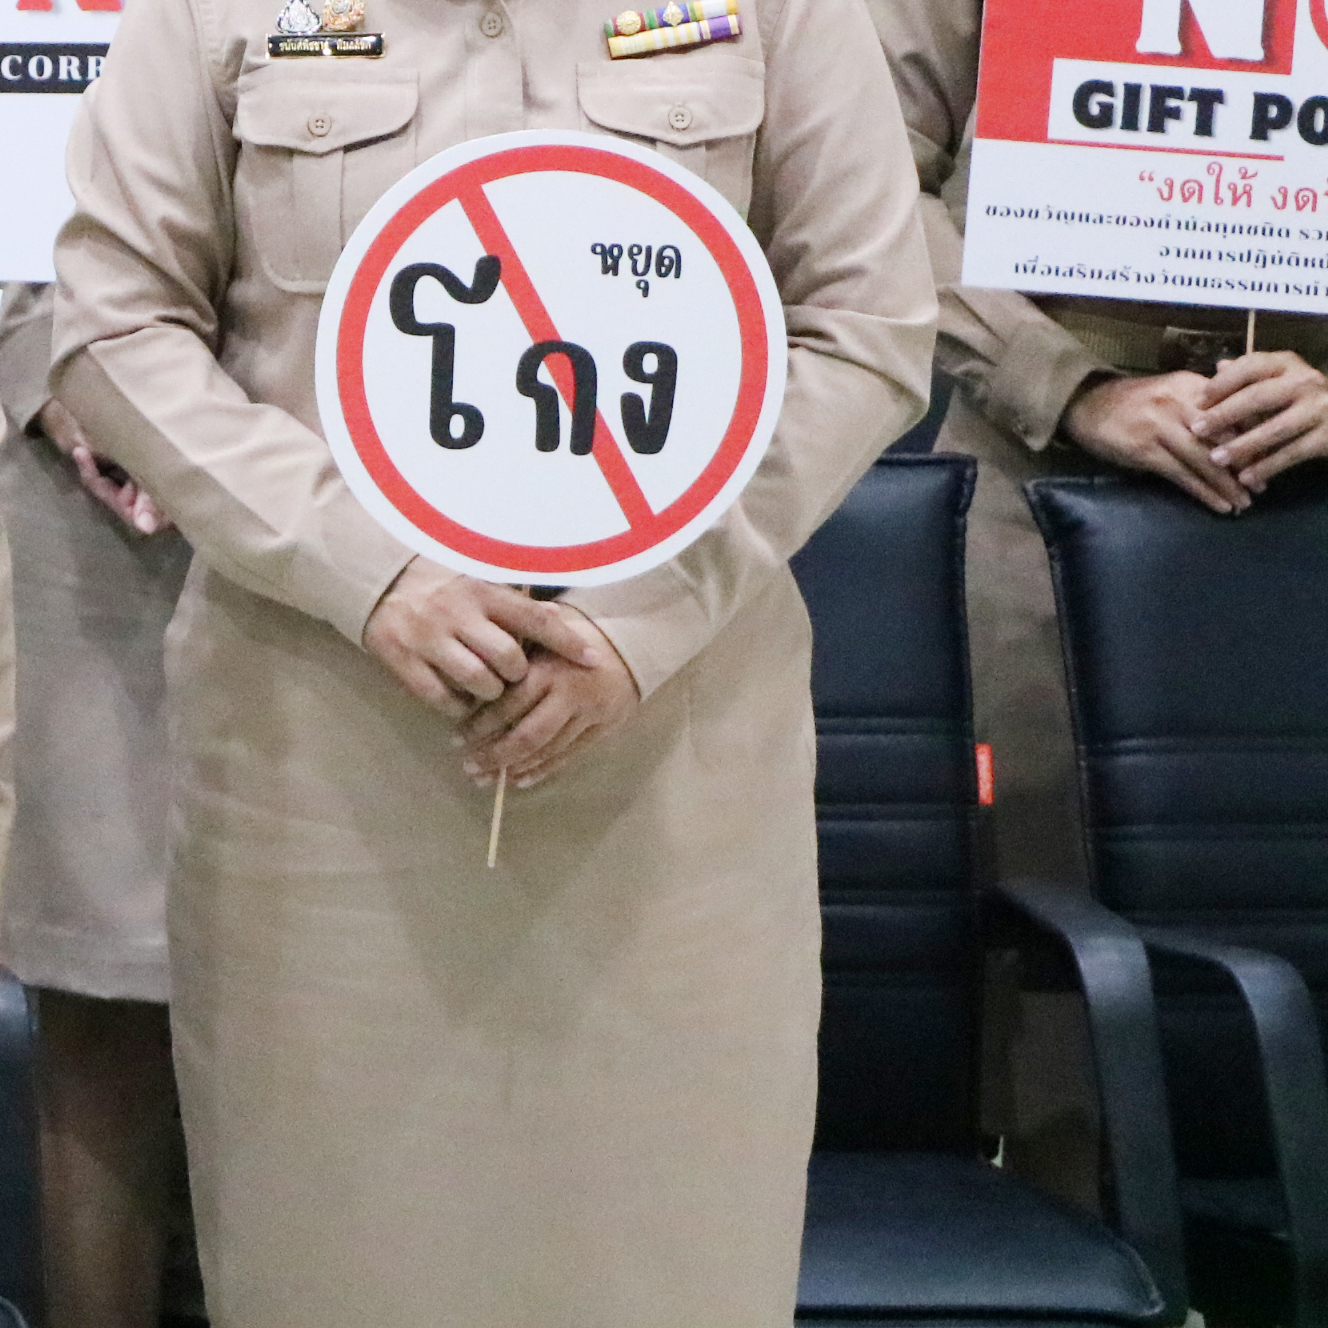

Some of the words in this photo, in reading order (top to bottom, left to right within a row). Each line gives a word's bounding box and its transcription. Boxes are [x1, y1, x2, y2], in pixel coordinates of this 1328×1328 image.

[1071, 80, 1226, 136] GIFT
[1270, 177, 1328, 213] งด
[591, 243, 682, 297] หยุด
[1159, 244, 1328, 271] จากการปฏิบัติหน
[389, 255, 678, 456] โกง
